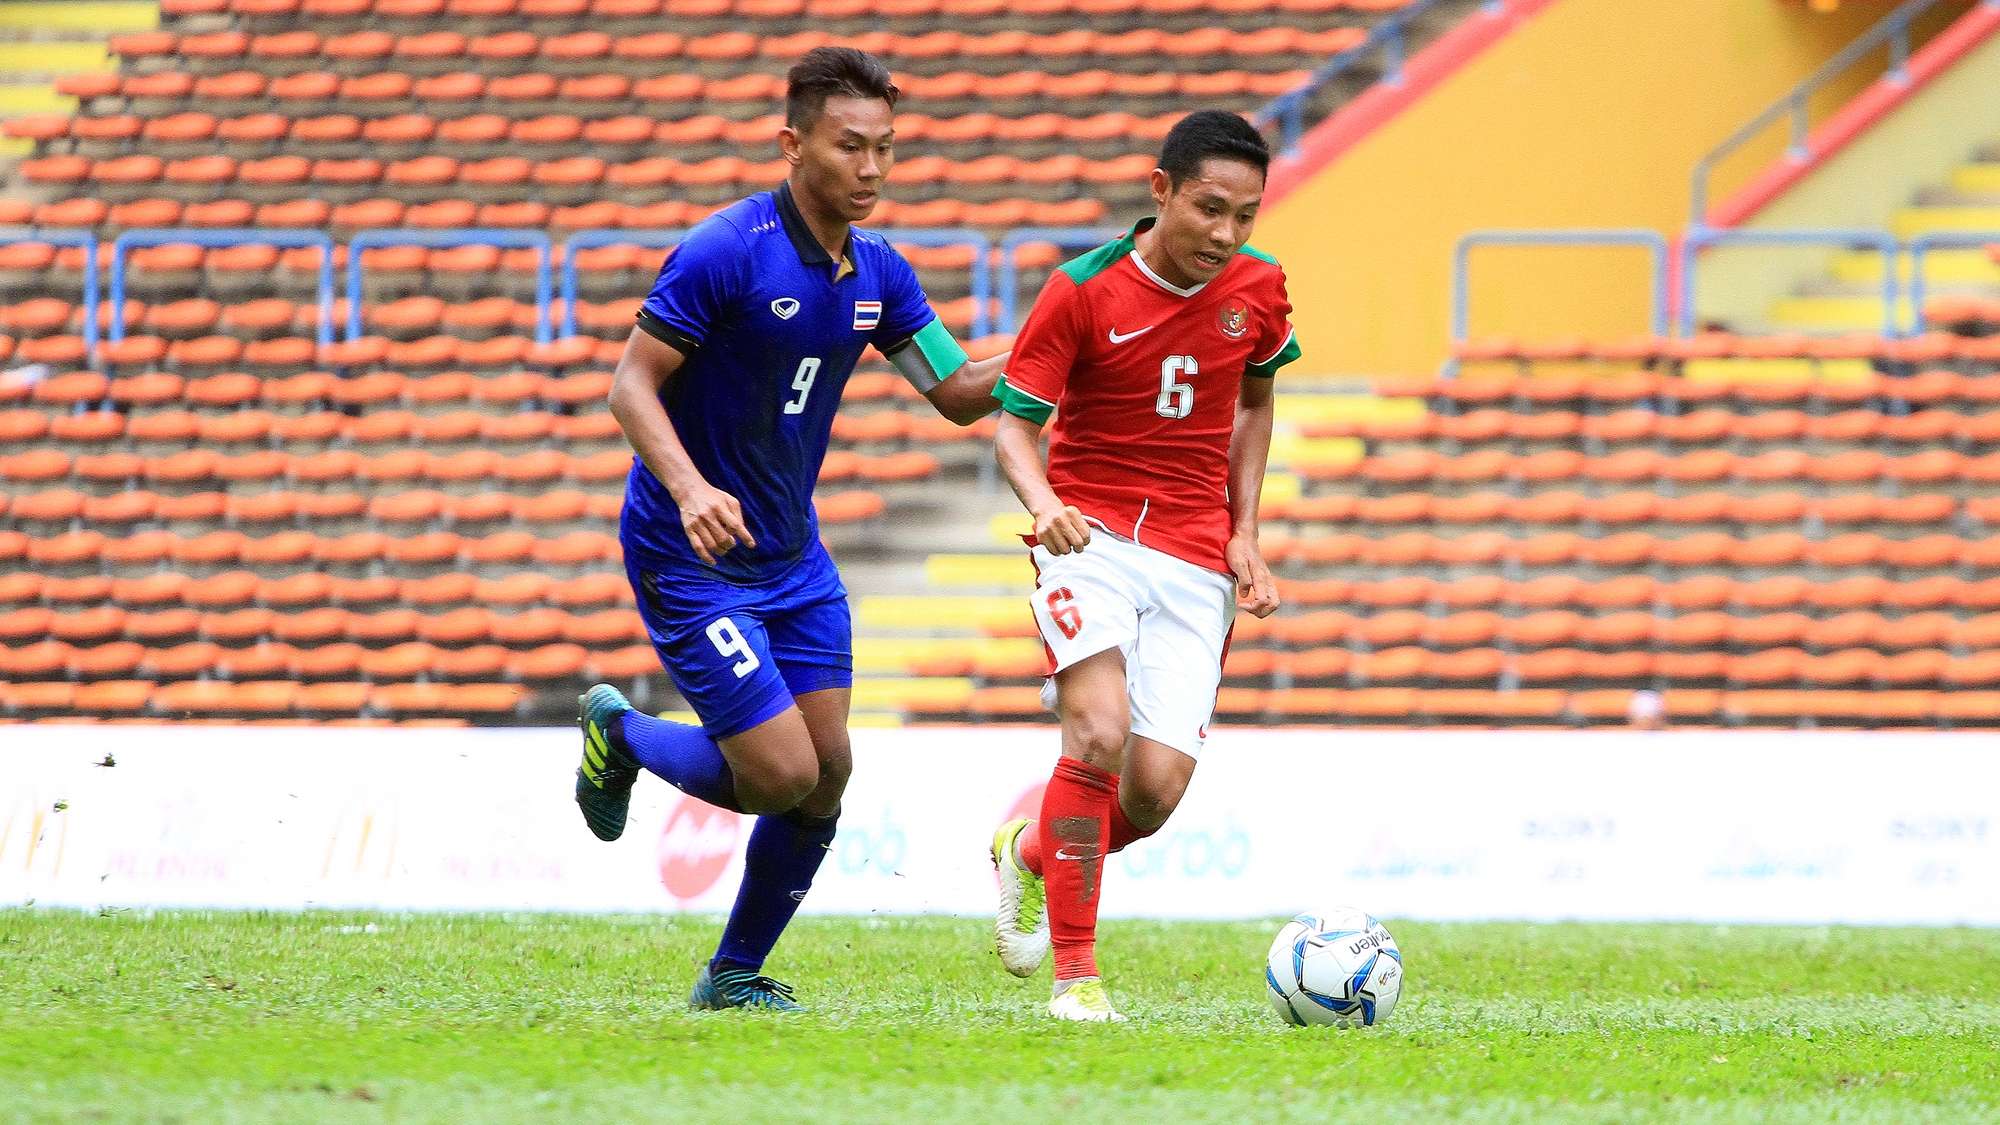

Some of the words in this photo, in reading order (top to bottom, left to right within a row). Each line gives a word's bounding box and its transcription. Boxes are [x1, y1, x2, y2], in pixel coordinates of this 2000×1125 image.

[783, 357, 822, 415] 9
[1155, 354, 1198, 419] 6
[1047, 586, 1083, 640] 6
[705, 616, 760, 679] 9
